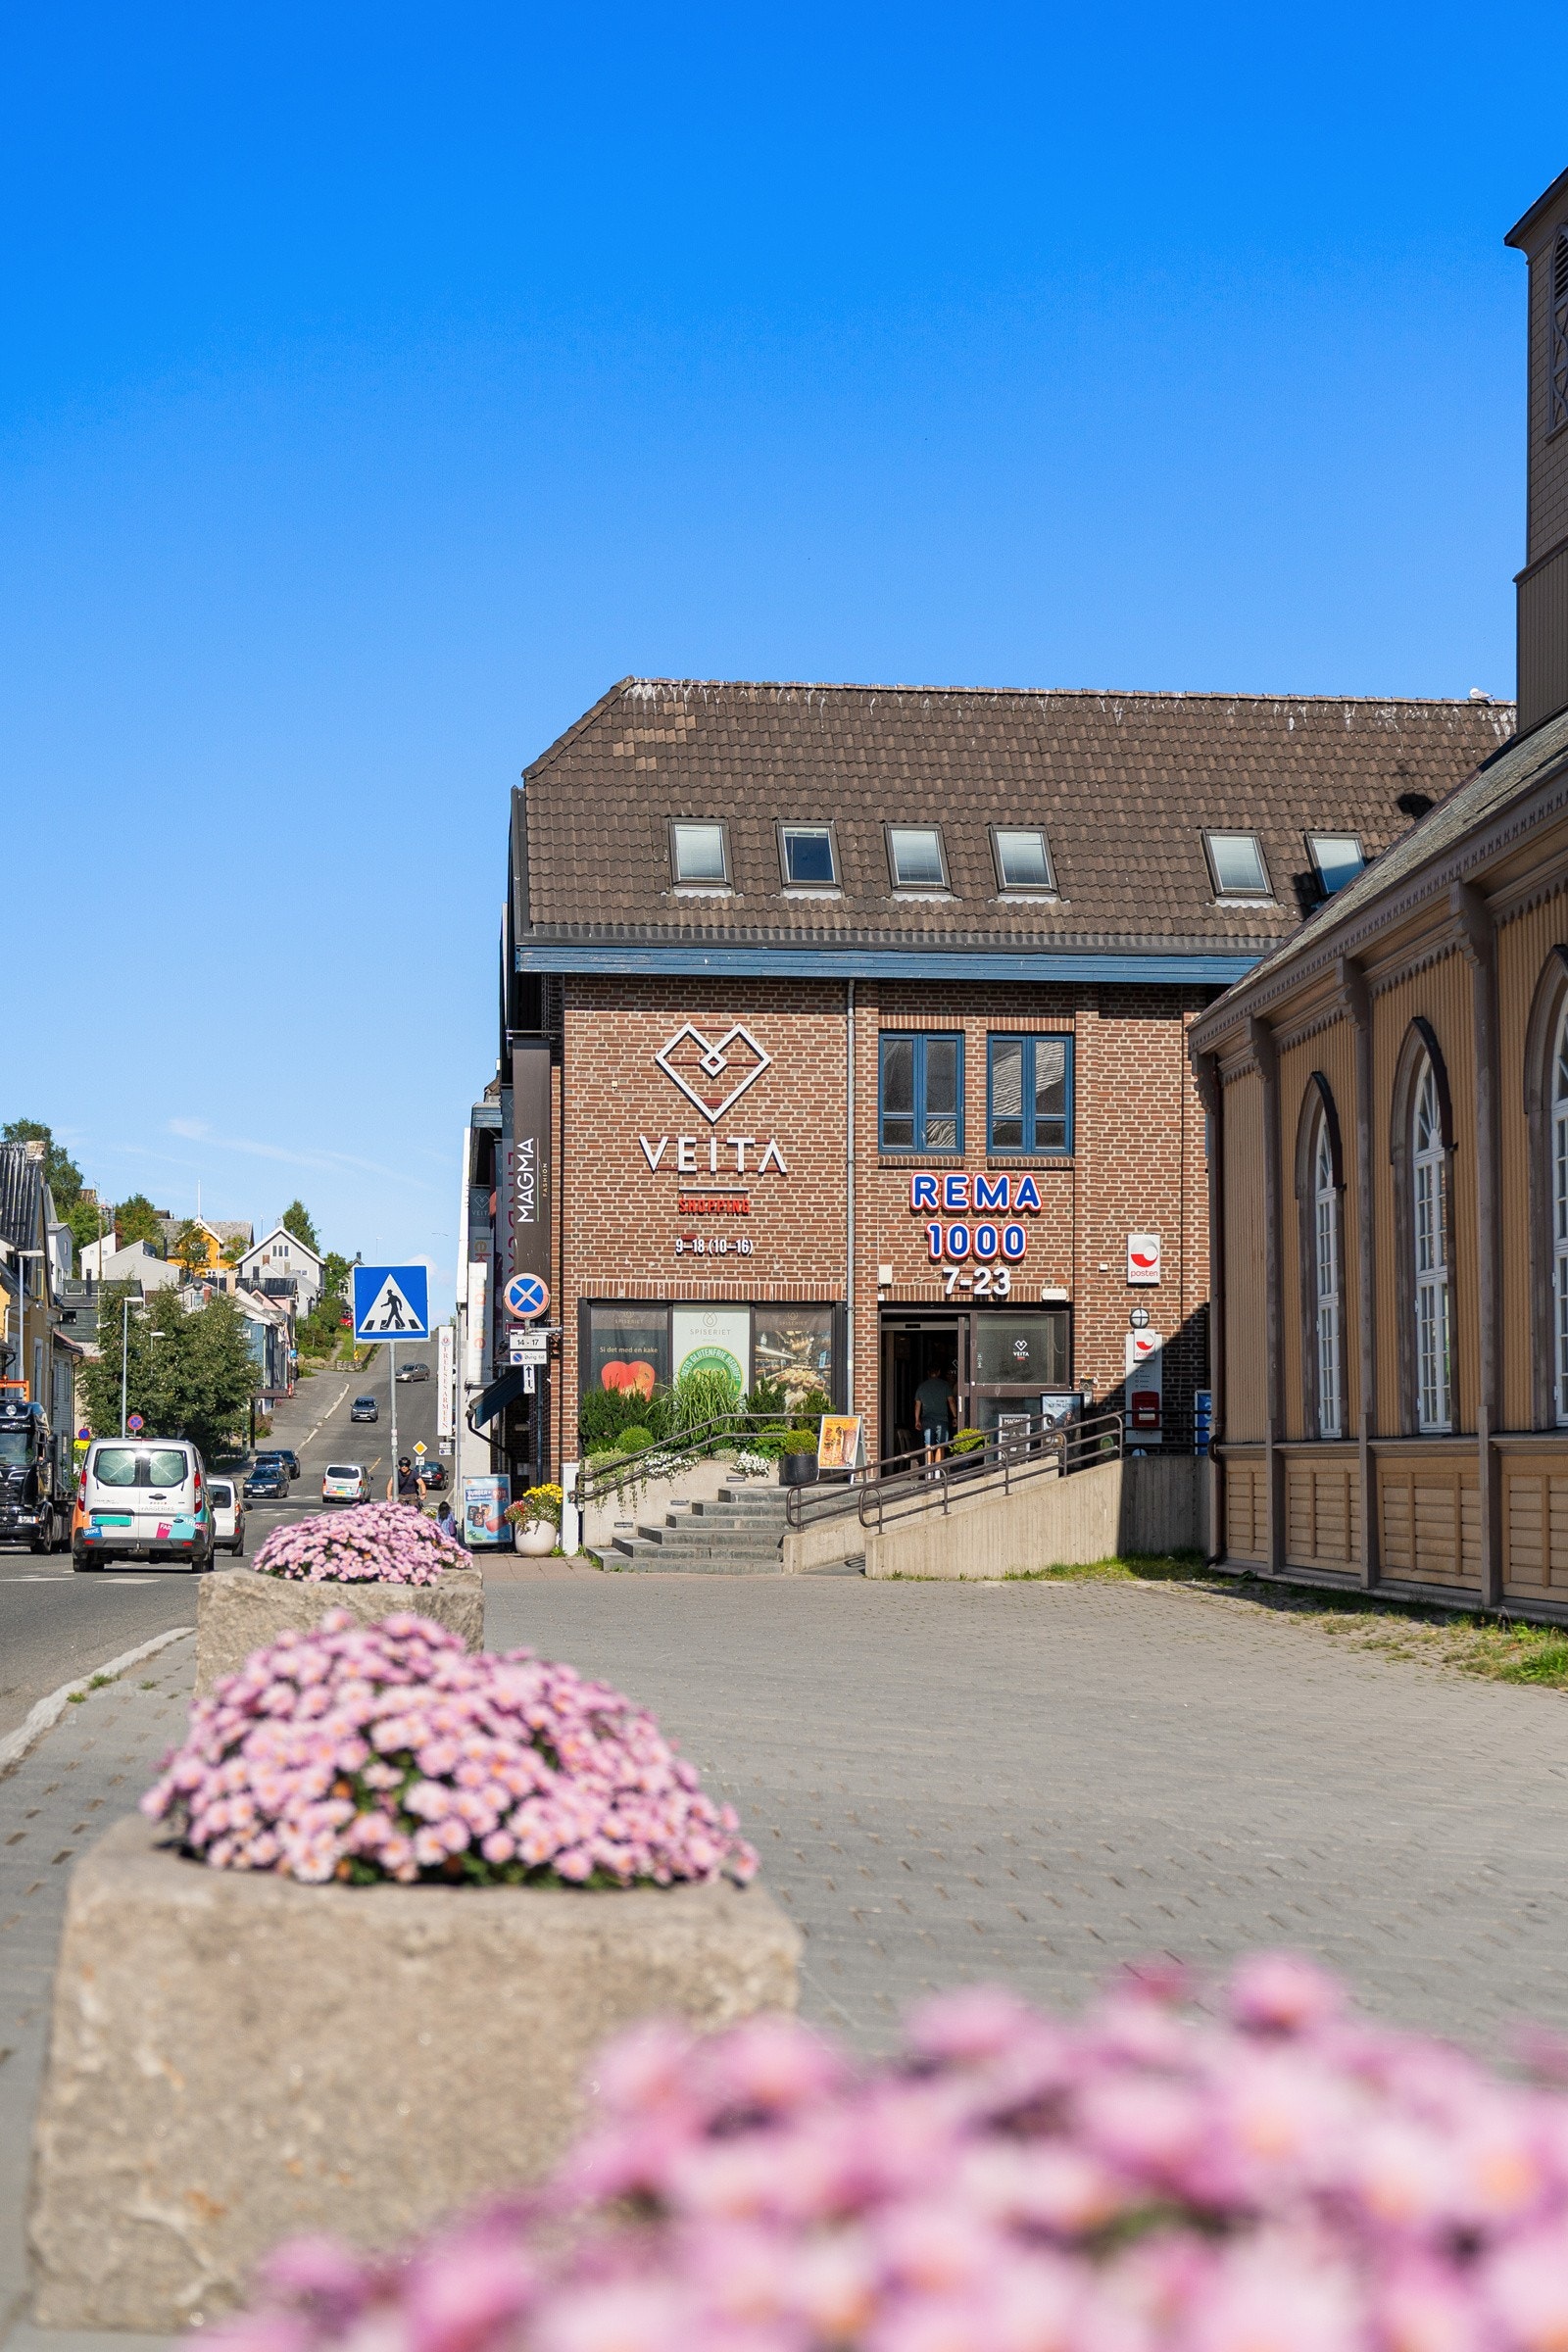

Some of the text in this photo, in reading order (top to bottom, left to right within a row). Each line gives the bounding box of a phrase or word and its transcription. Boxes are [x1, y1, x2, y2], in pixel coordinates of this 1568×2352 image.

[639, 1135, 788, 1174] VEITA
[516, 1138, 534, 1223] MAGMA
[910, 1172, 1042, 1211] REMA
[678, 1199, 750, 1214] SHOPPING
[925, 1220, 1027, 1260] 1000
[942, 1266, 1010, 1296] 7-23
[689, 1348, 728, 1362] GLUTENFRIE
